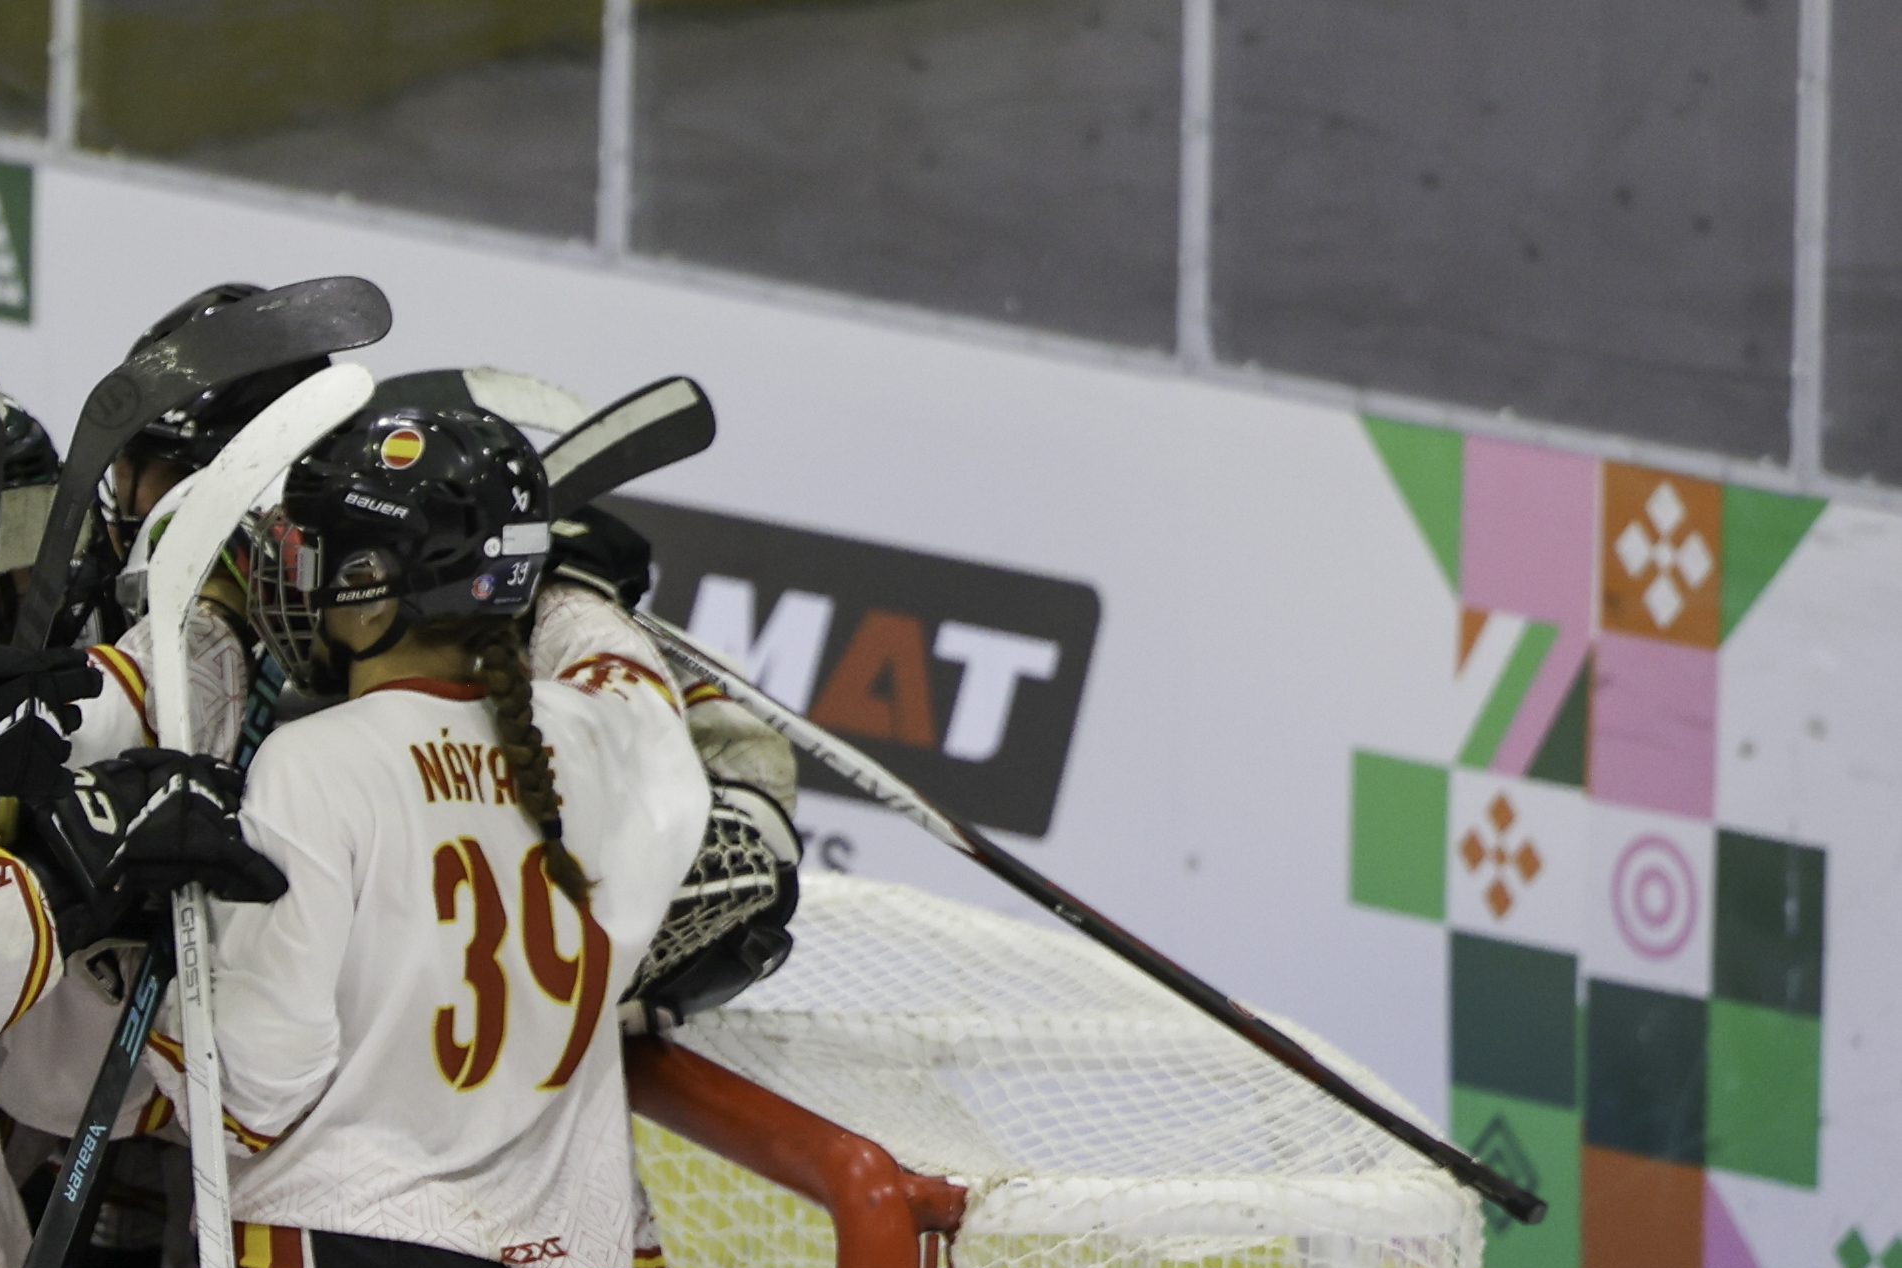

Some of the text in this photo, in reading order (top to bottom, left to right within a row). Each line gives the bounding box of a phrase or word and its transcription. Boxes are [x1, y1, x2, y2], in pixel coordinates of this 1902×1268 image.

[344, 491, 410, 520] BAUER
[506, 561, 529, 587] 39
[643, 563, 1060, 763] MAT
[181, 905, 202, 1006] GHOST
[432, 836, 611, 1092] 39
[63, 1134, 98, 1203] BAUER
